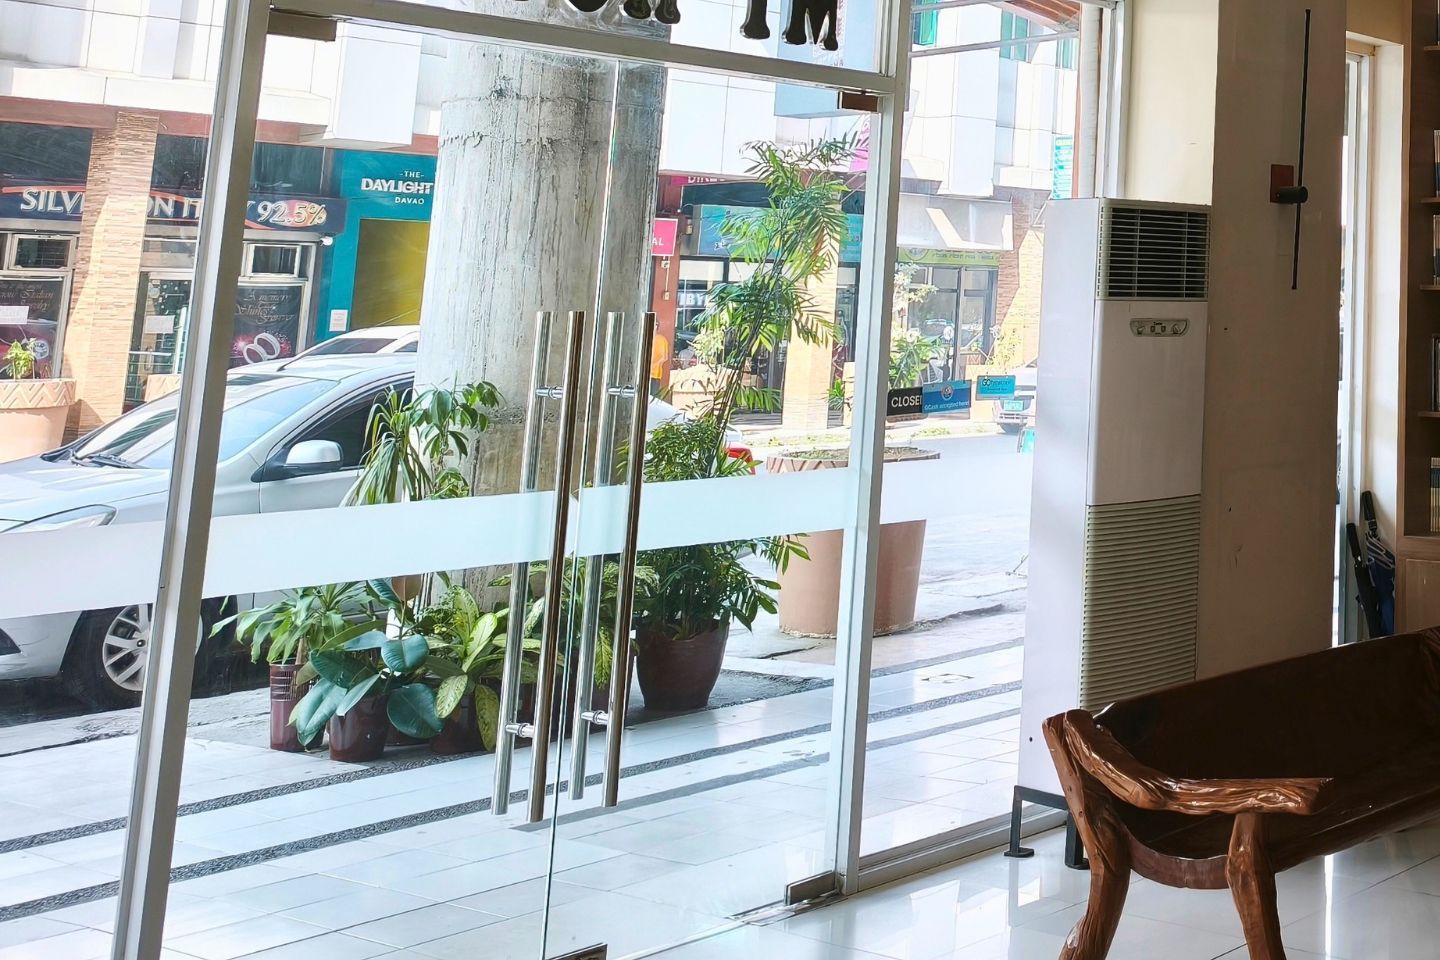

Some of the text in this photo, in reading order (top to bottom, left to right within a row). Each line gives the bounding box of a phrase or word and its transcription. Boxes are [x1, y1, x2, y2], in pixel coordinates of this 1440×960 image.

[360, 178, 434, 195] DAYLIGHT
[394, 196, 425, 205] DAVAO
[256, 200, 328, 225] 92.5%
